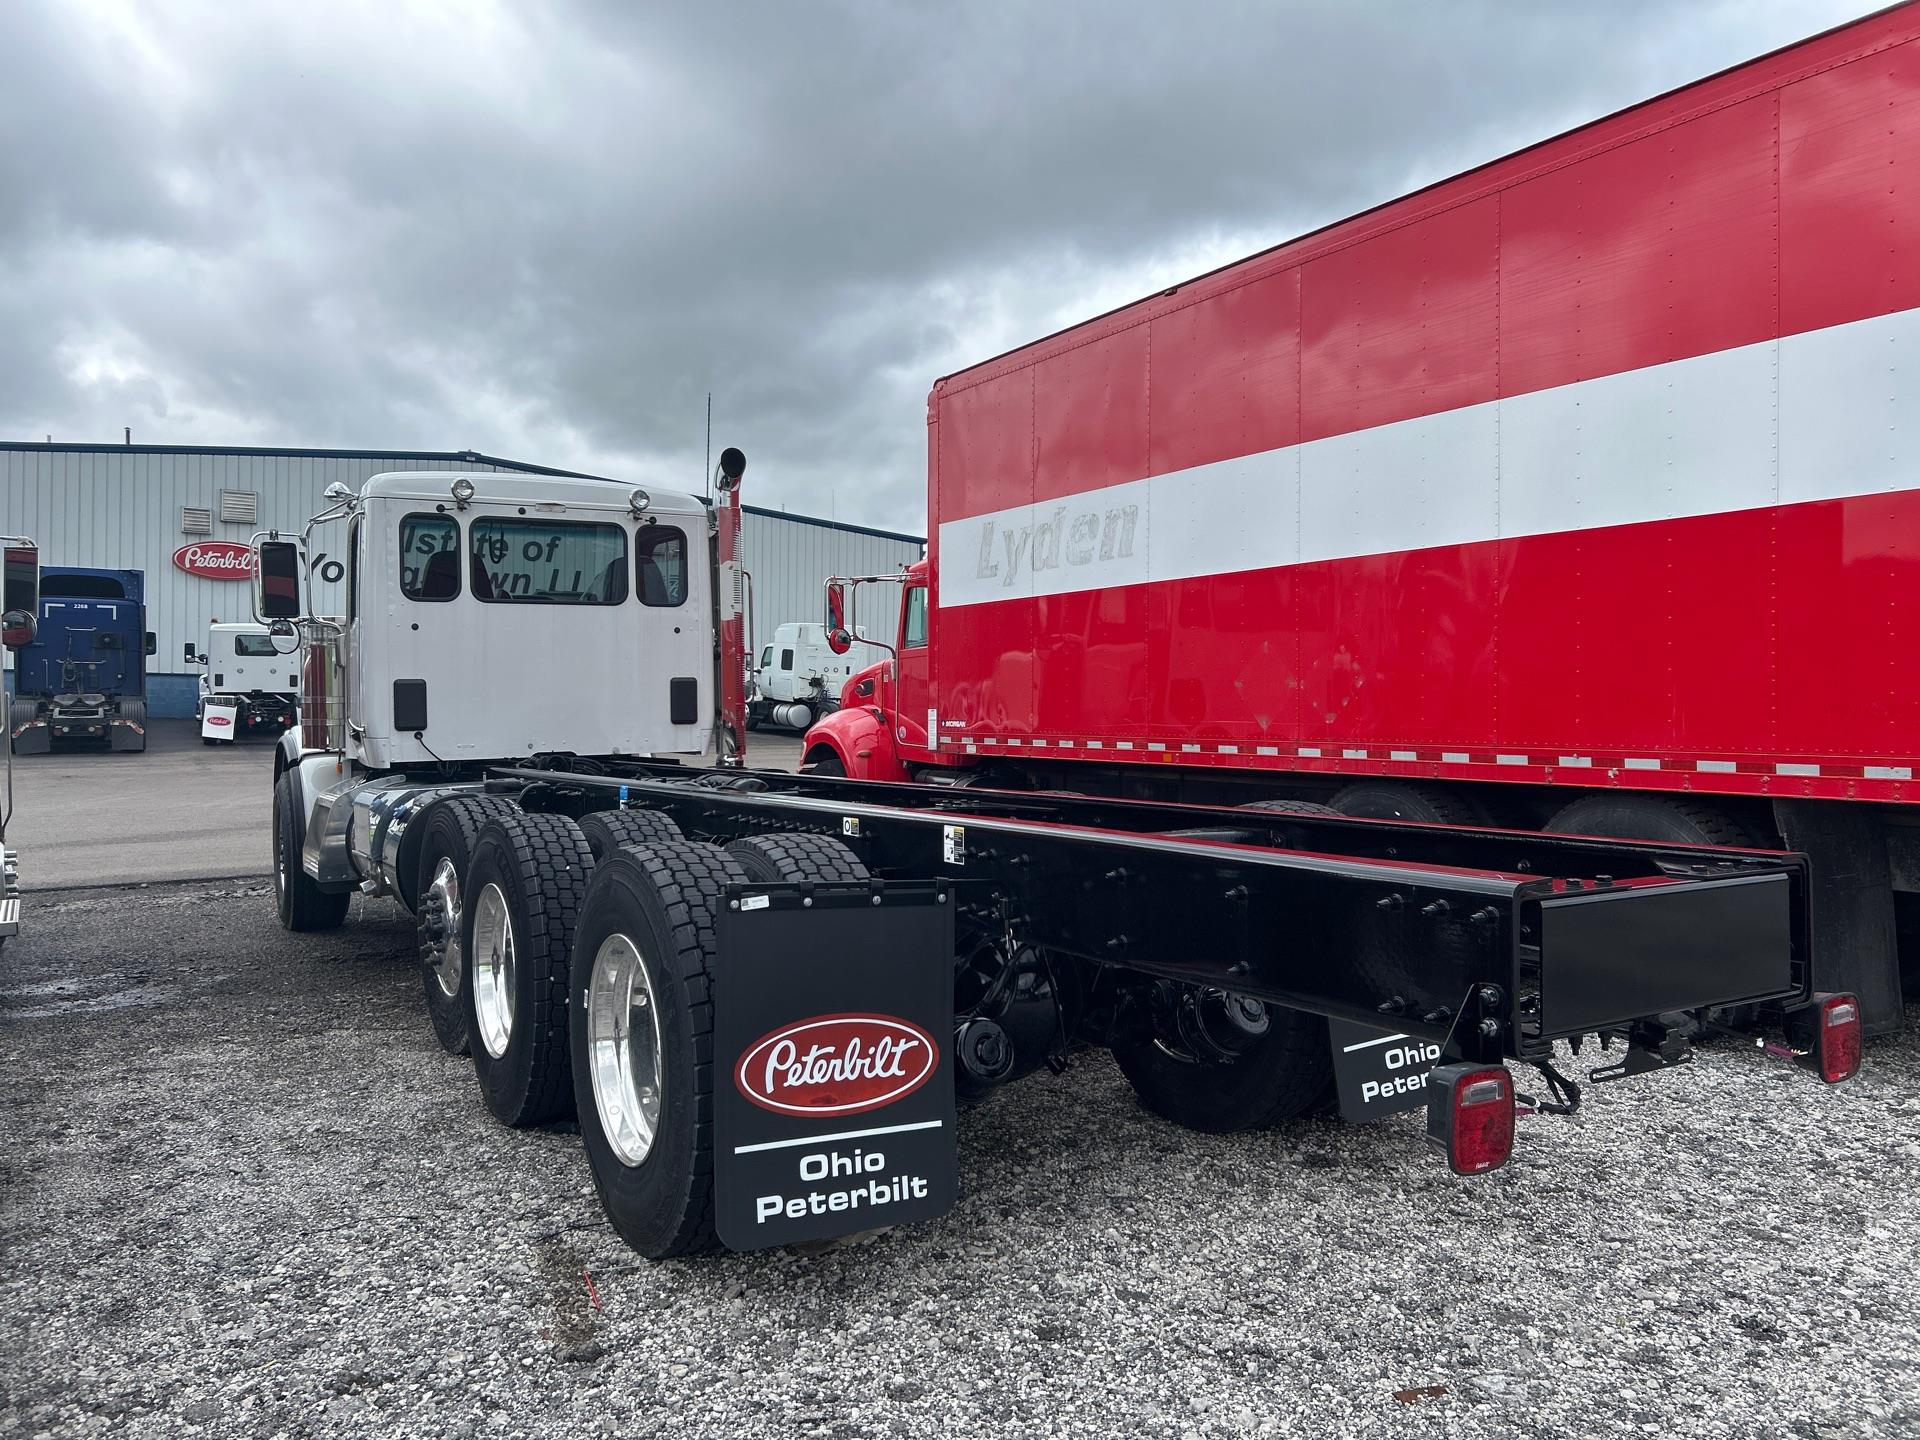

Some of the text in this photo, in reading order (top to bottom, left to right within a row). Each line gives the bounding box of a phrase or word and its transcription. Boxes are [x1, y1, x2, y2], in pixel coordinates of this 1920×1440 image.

[522, 535, 562, 563] of
[976, 504, 1138, 587] Lyden
[765, 1035, 919, 1094] Peterbilt
[1384, 1042, 1440, 1070] Ohio
[1361, 1065, 1435, 1103] Peter
[799, 1149, 885, 1181] Ohio
[756, 1175, 928, 1224] Peterbilt
